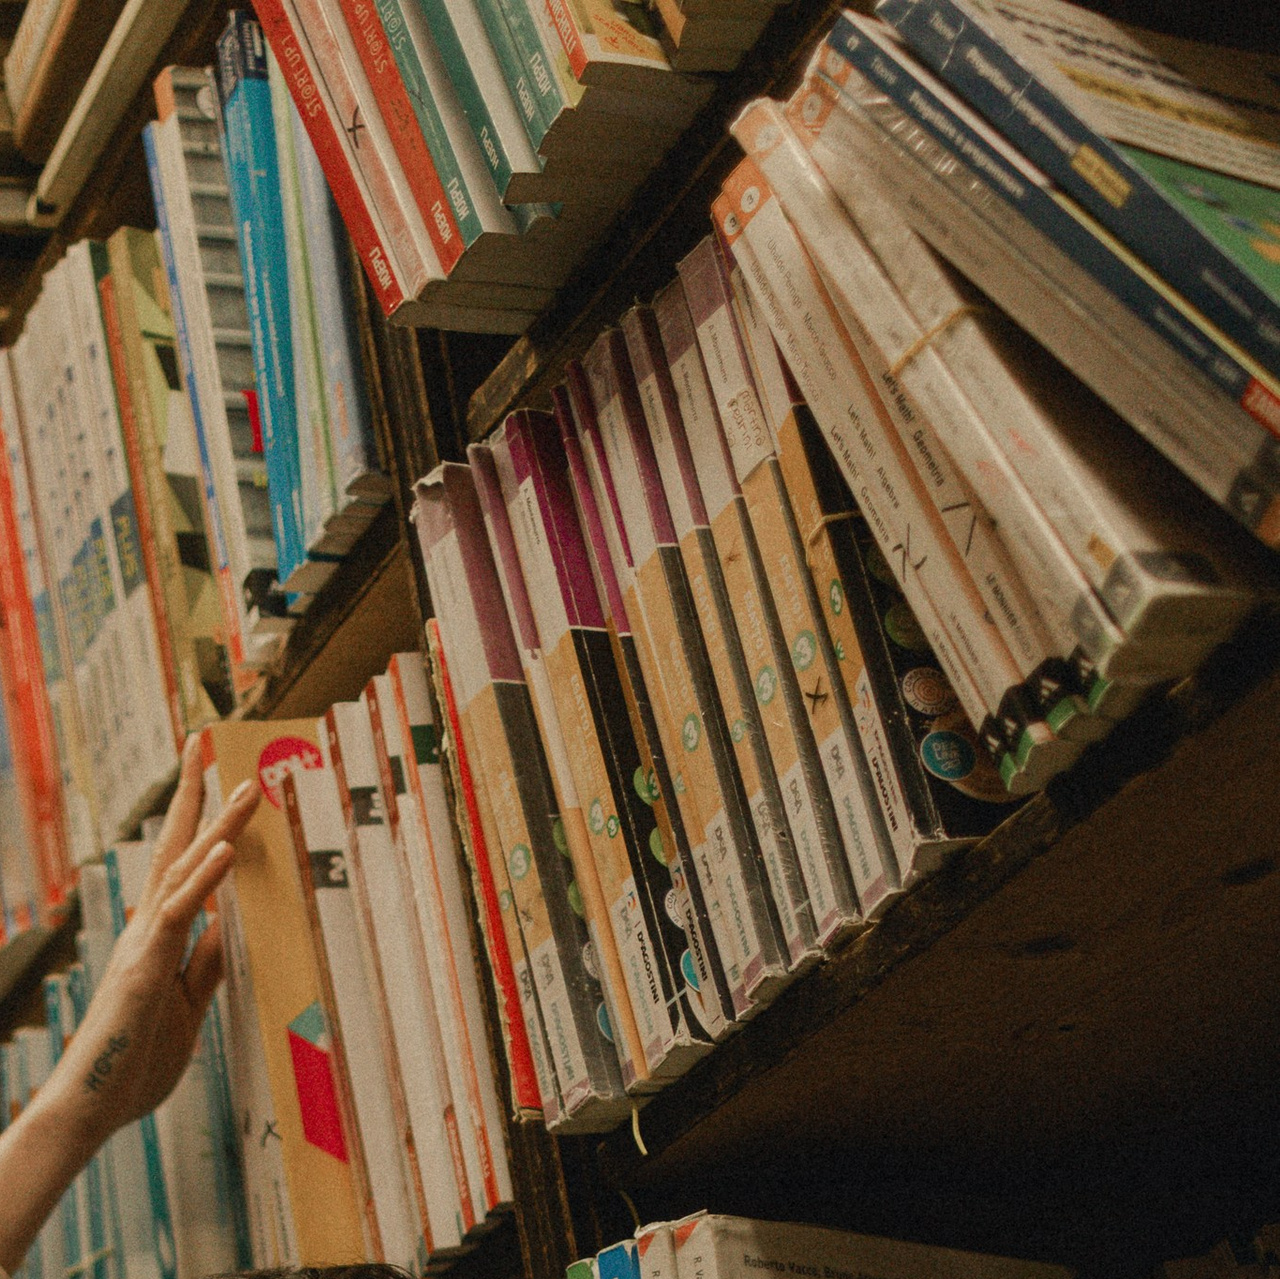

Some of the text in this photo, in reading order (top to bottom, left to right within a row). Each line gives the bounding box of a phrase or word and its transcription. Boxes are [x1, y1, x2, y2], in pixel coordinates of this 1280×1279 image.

[356, 4, 369, 24] UP
[285, 47, 300, 68] UP
[529, 52, 552, 97] HOEPLI
[516, 76, 536, 122] HOEPLI
[480, 126, 499, 170] HOEPLI
[448, 177, 470, 222] HOEPLI
[430, 200, 453, 244] HOEPLI
[370, 246, 392, 290] HOEPLI
[882, 371, 898, 396] Let's
[894, 395, 914, 424] Math!
[912, 430, 946, 487] Geometria
[875, 466, 901, 510] Algebra
[859, 486, 891, 543] Geometria
